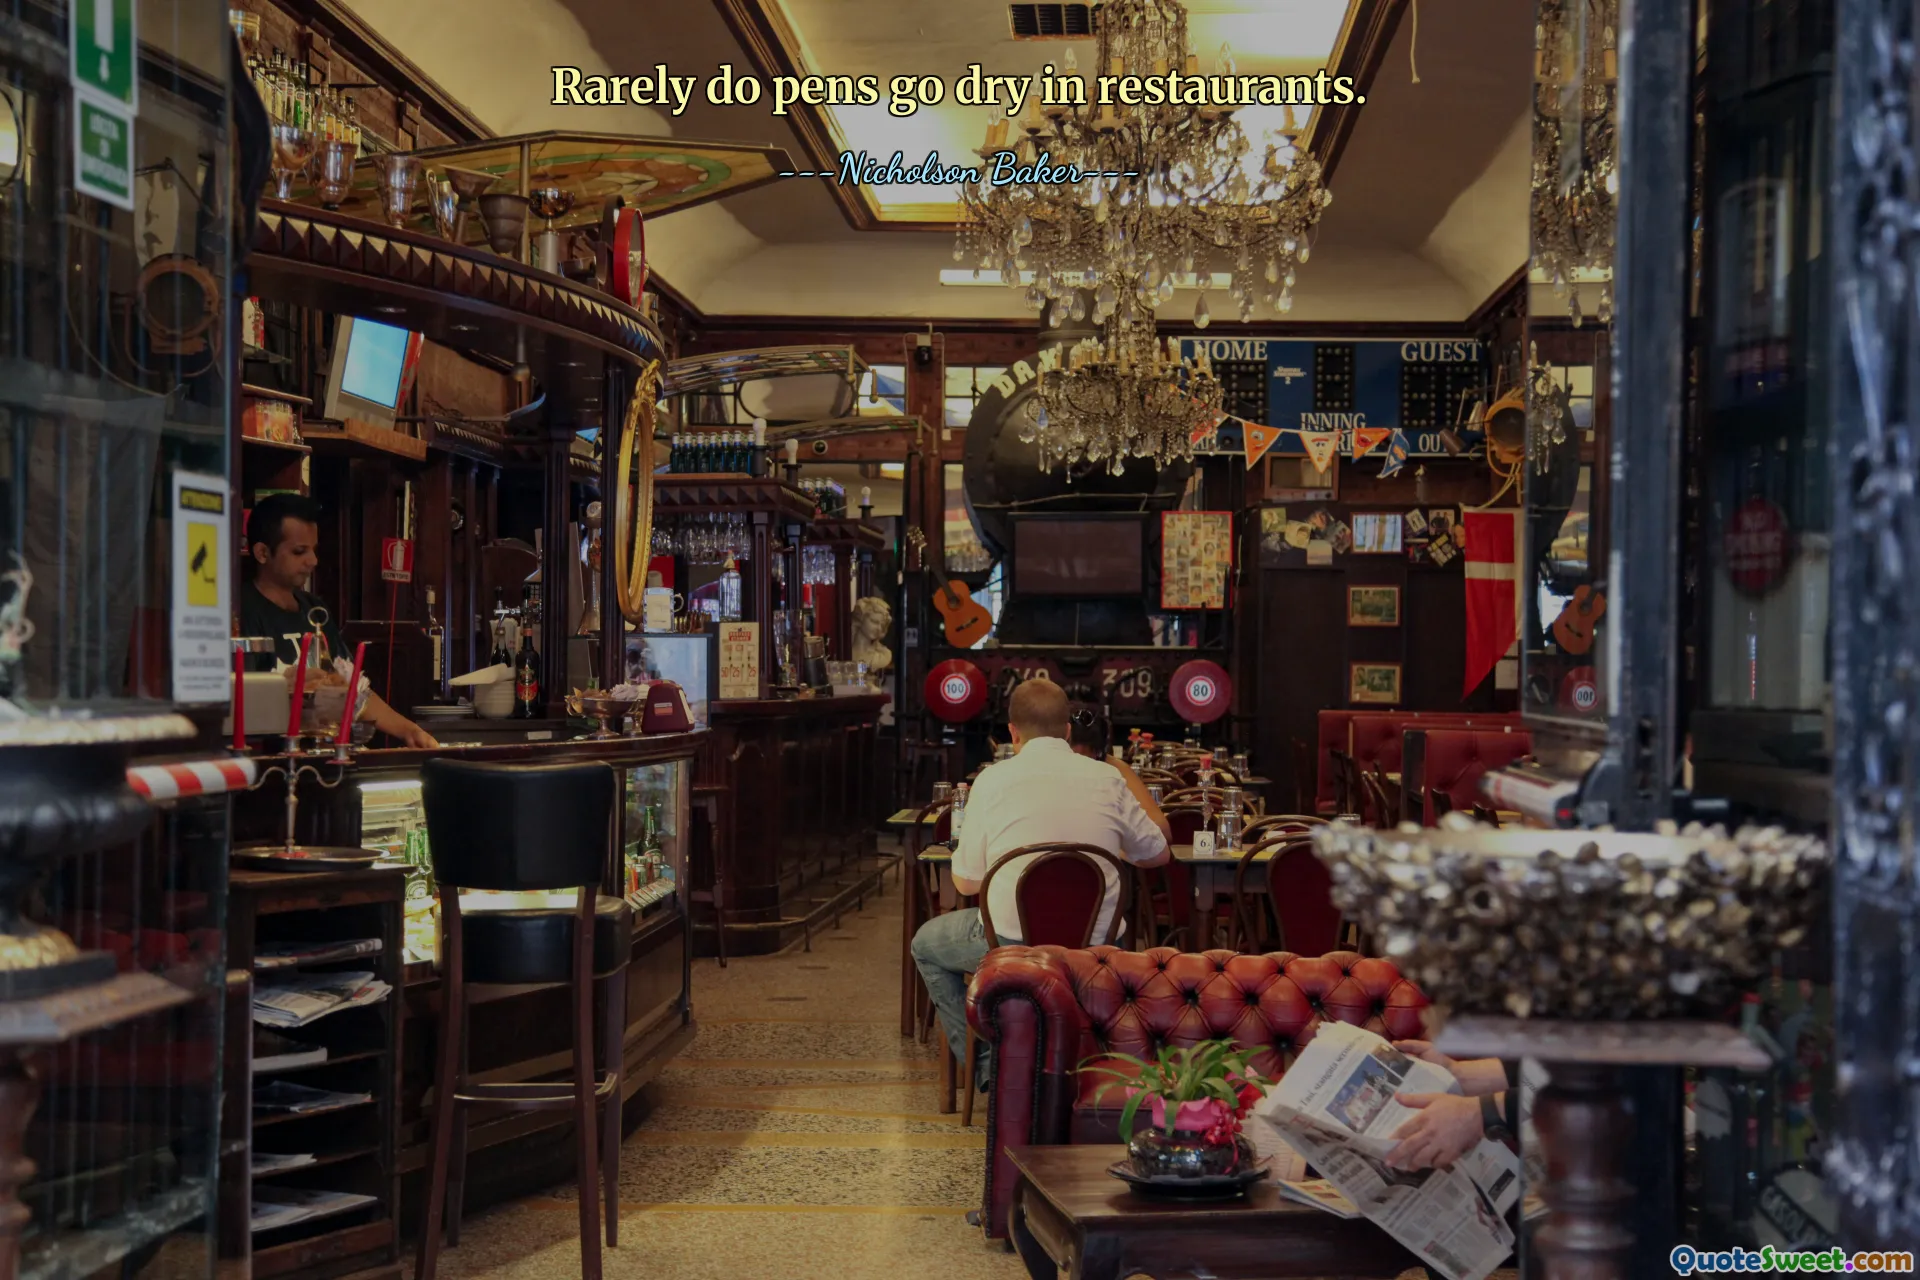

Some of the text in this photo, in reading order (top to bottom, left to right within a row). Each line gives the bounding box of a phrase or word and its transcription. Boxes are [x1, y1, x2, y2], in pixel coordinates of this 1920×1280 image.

[1193, 340, 1268, 361] HOME
[1401, 341, 1482, 362] GUEST
[1300, 413, 1366, 431] INNING
[1418, 433, 1449, 452] OU
[732, 666, 740, 678] 25
[748, 666, 757, 678] 25
[946, 682, 965, 694] 100
[1193, 684, 1209, 697] 80
